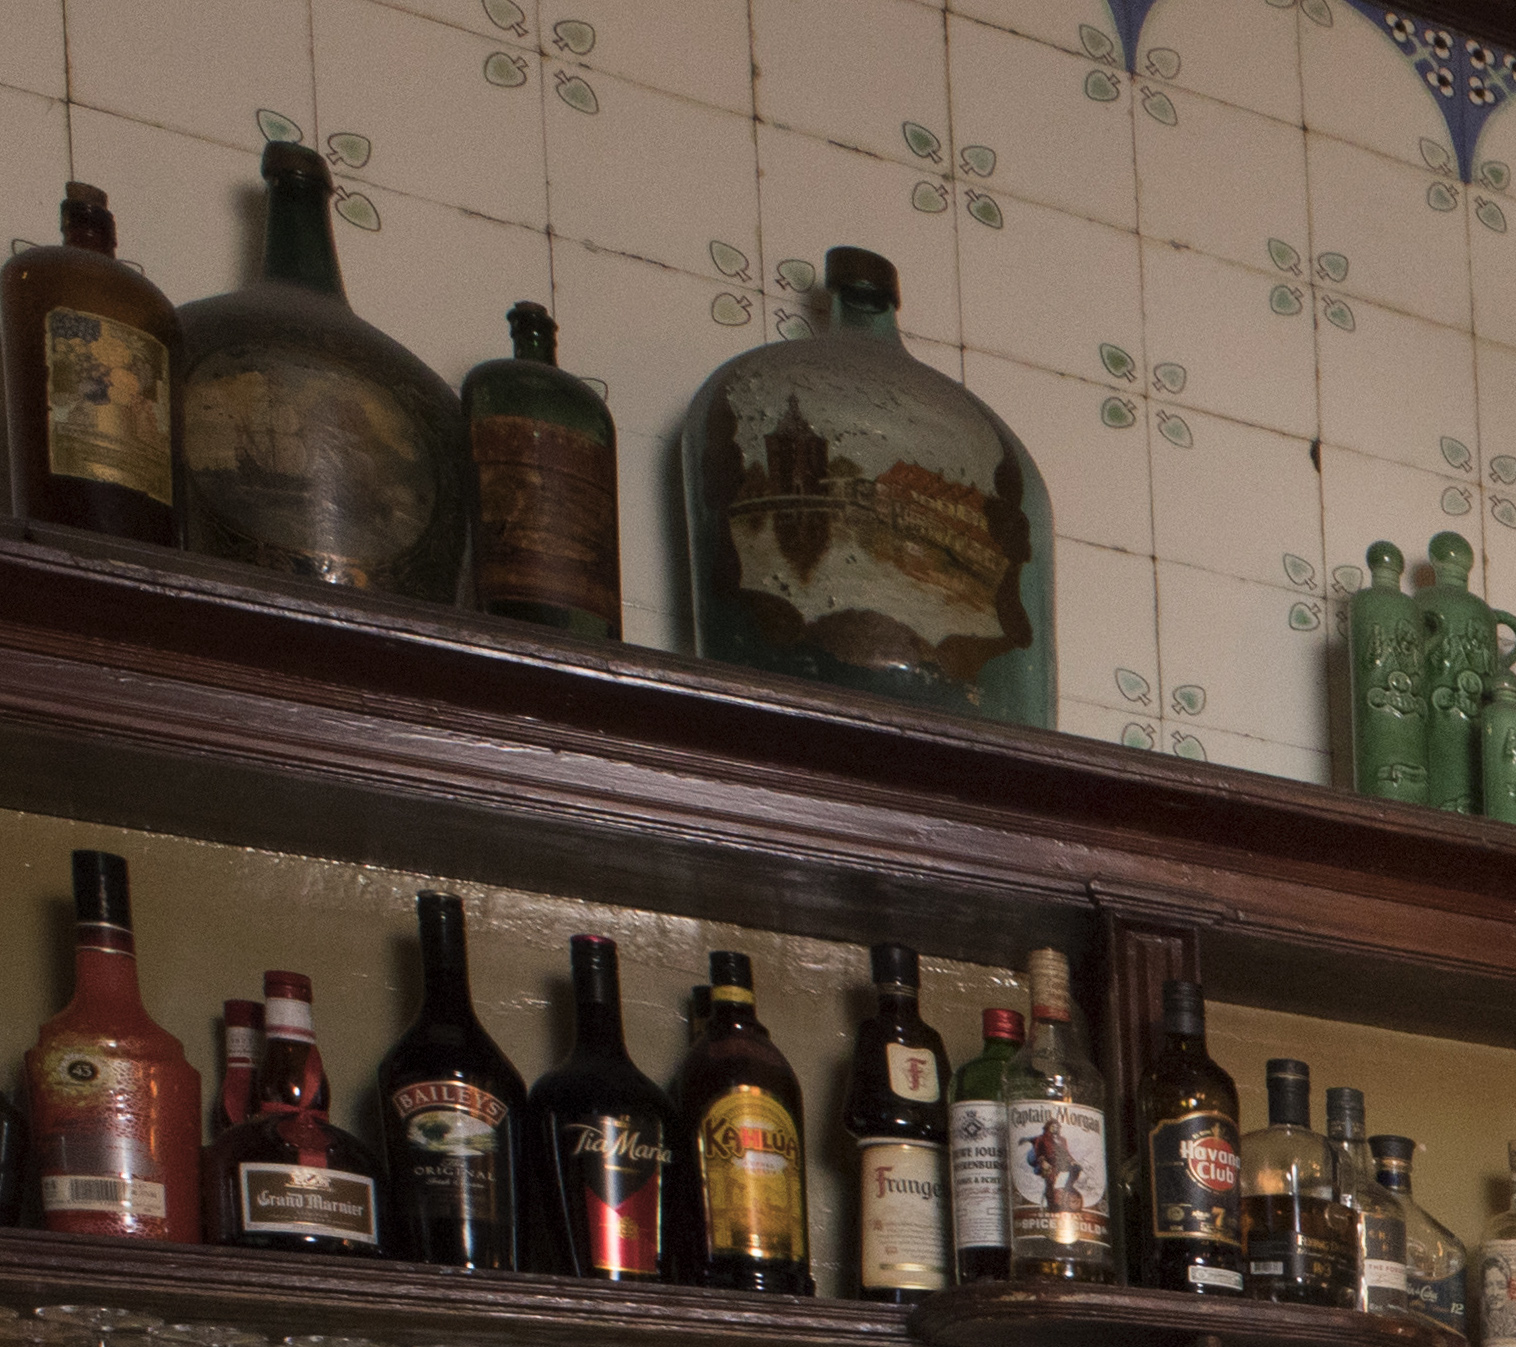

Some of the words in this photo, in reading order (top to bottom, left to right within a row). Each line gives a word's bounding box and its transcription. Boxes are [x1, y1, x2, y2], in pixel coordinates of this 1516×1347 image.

[73, 1062, 93, 1077] 43
[400, 1084, 501, 1116] BAILEYS
[1010, 1105, 1051, 1129] Captain
[1055, 1106, 1101, 1135] Morgan
[704, 1116, 798, 1160] KAHLÚA
[413, 1165, 496, 1182] ORIGINAL
[1197, 1161, 1235, 1184] Club
[256, 1194, 304, 1209] Grand
[307, 1193, 364, 1217] Marnier
[1210, 1206, 1226, 1228] 7
[1451, 1303, 1465, 1314] 12
